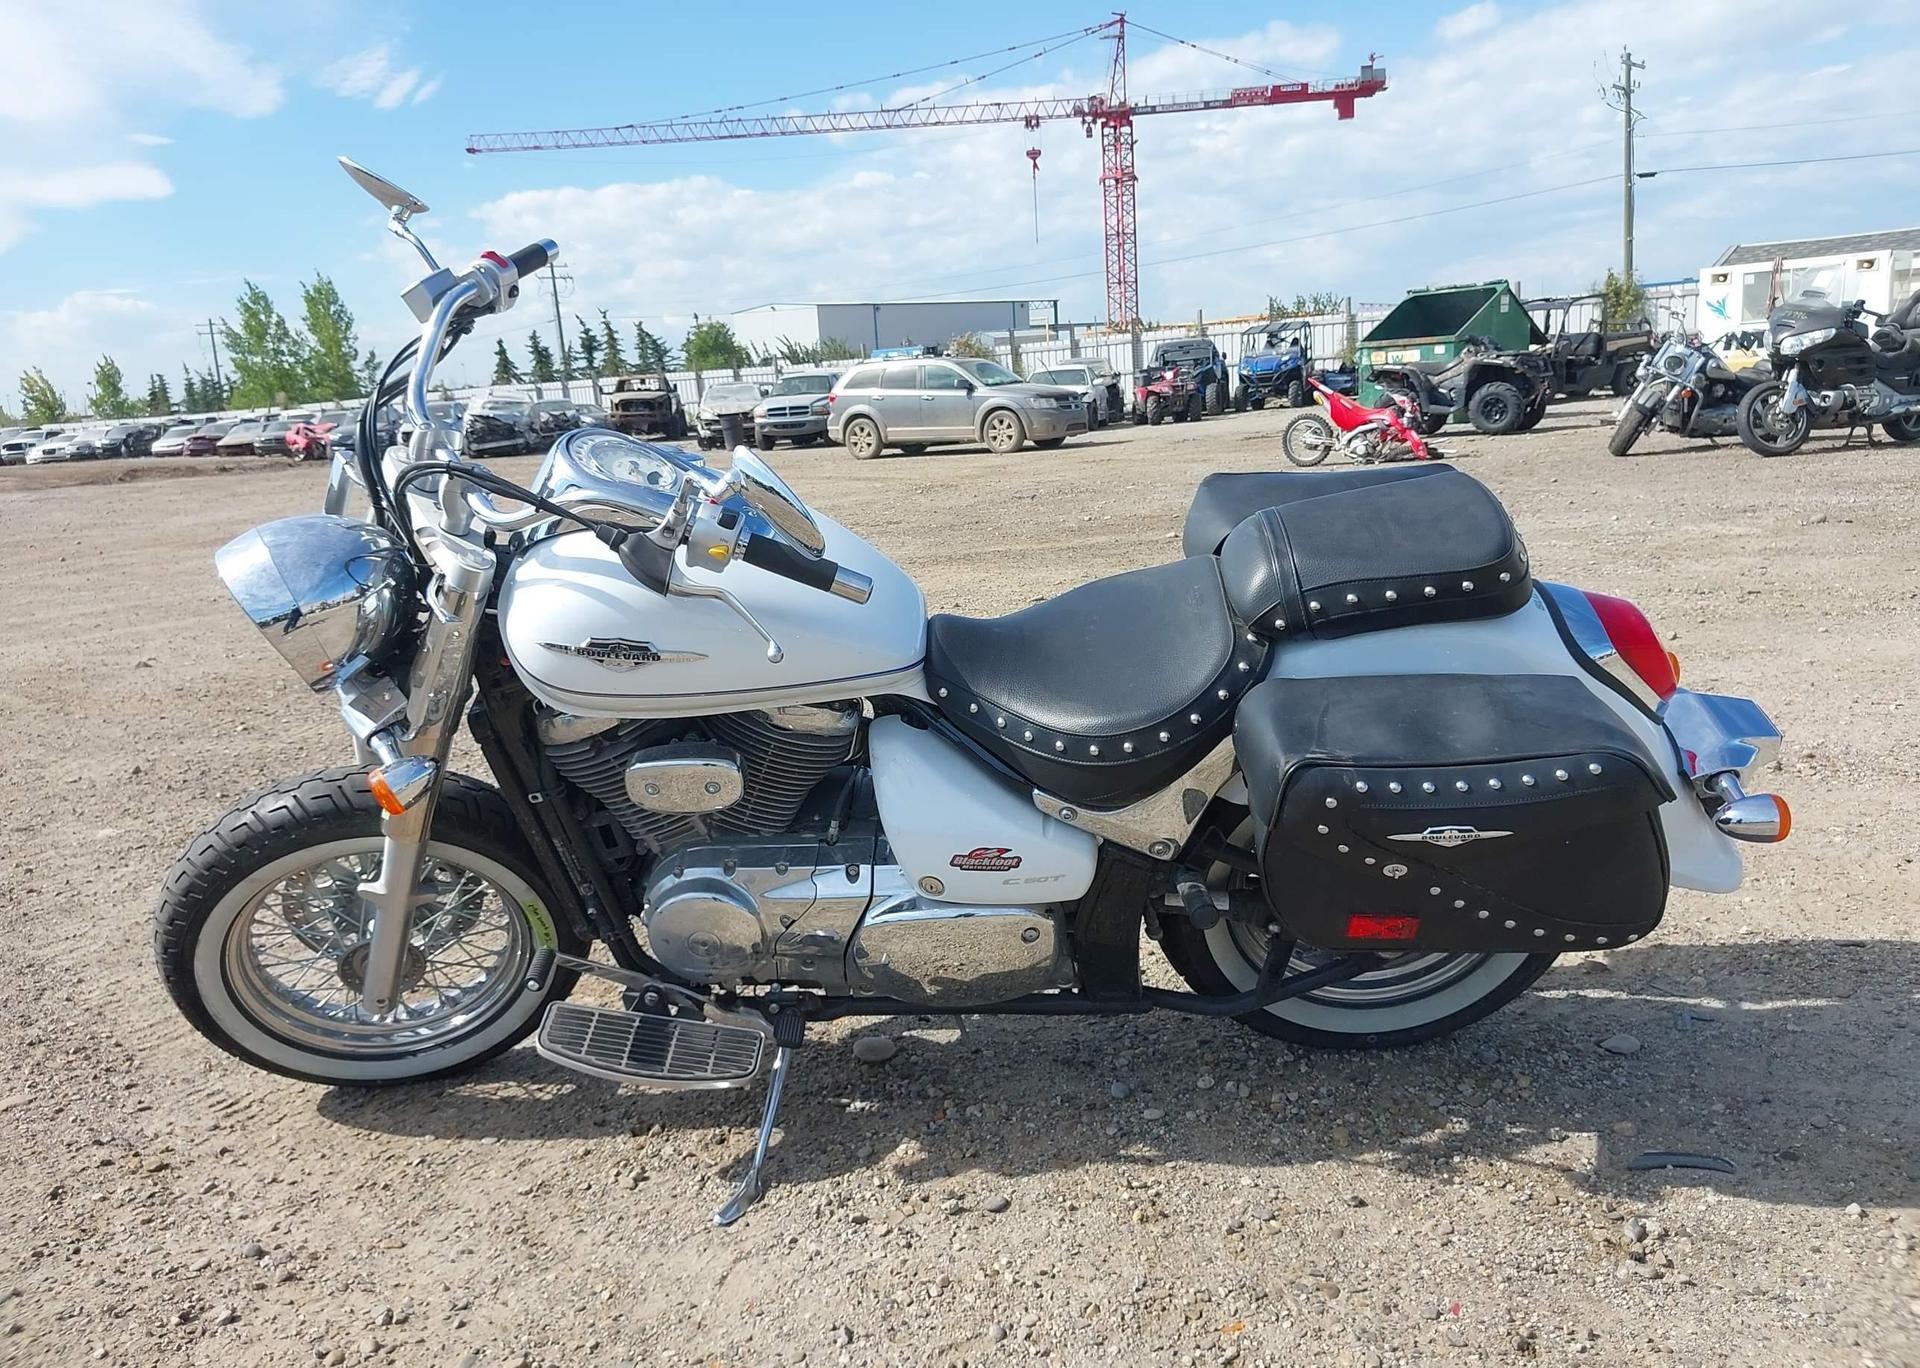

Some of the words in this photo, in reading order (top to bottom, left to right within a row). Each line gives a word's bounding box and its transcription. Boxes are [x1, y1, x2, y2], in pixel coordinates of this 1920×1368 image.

[577, 648, 661, 661] BOULEVARD
[1421, 833, 1481, 841] BOULEVARD
[953, 856, 1018, 867] Blackfoot
